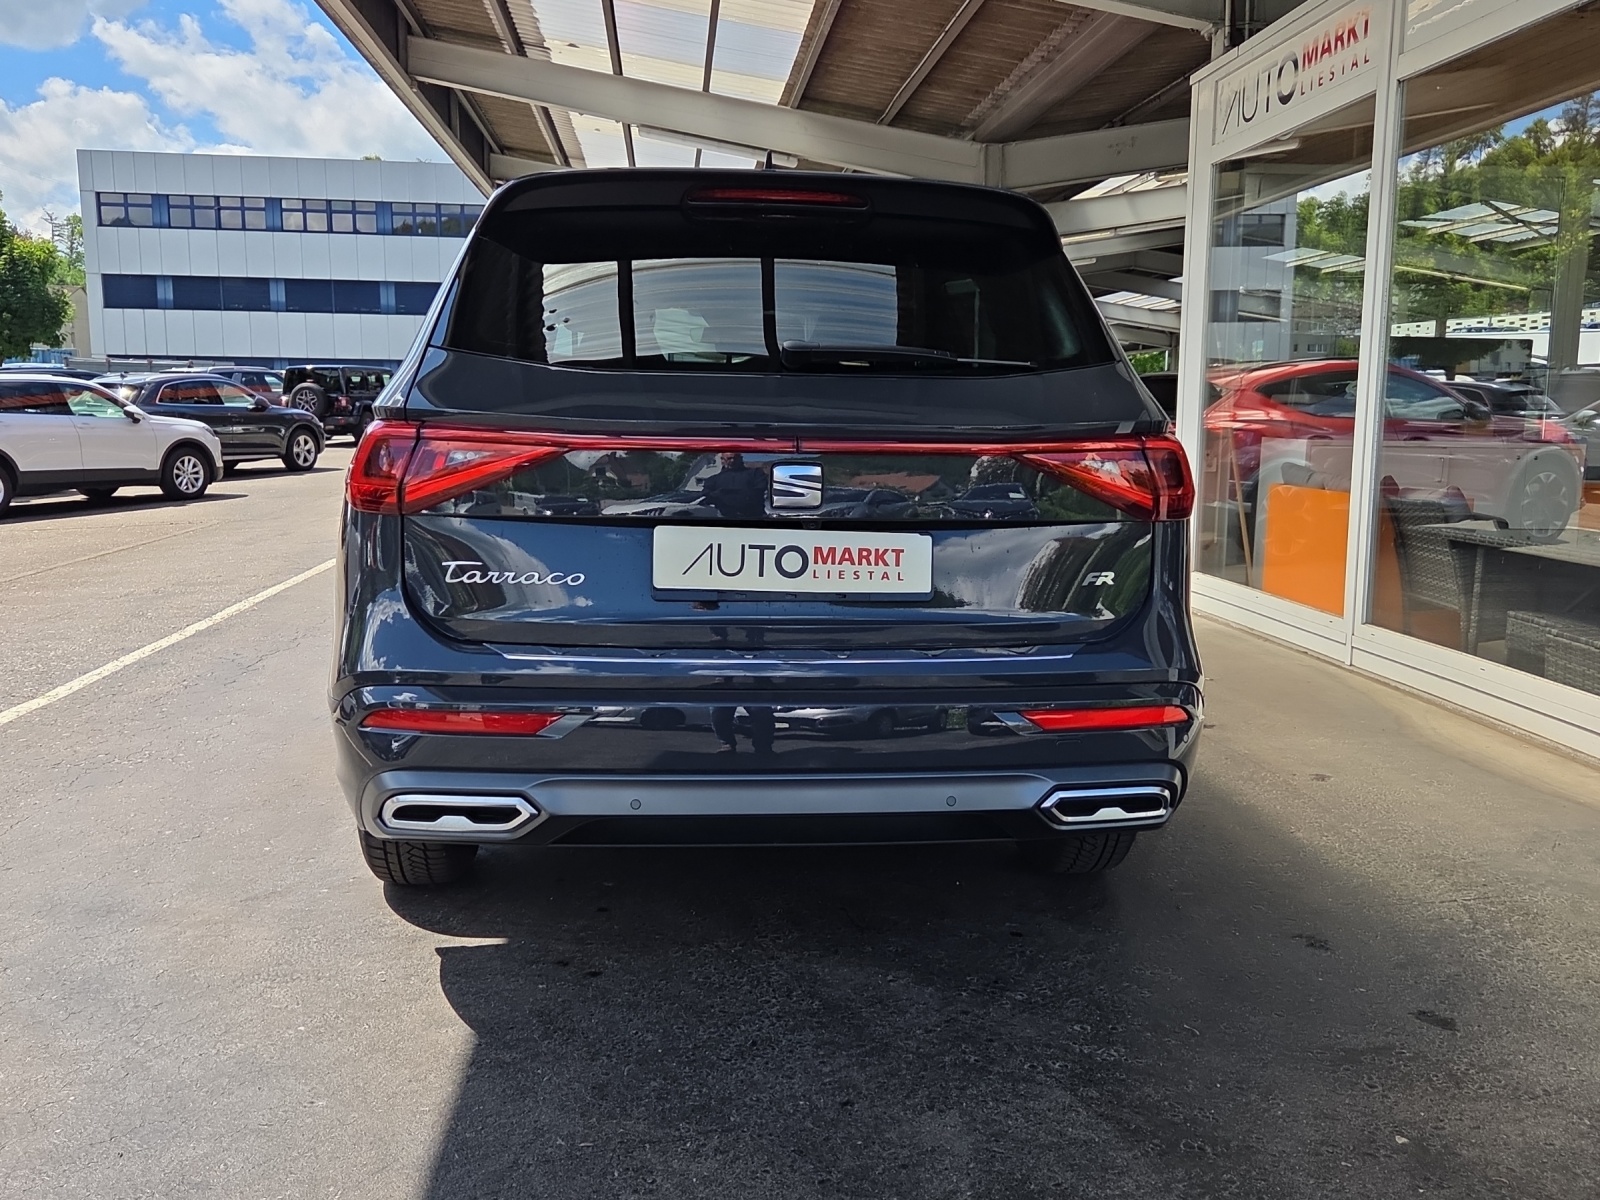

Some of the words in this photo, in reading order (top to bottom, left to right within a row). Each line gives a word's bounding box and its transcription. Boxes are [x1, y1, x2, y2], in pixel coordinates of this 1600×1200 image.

[1300, 48, 1370, 97] LIESTAL
[441, 560, 586, 586] Tarraco
[682, 542, 810, 579] AUTO
[813, 546, 905, 568] MARKT
[812, 569, 905, 582] LIESTAL
[1081, 571, 1115, 586] FR
